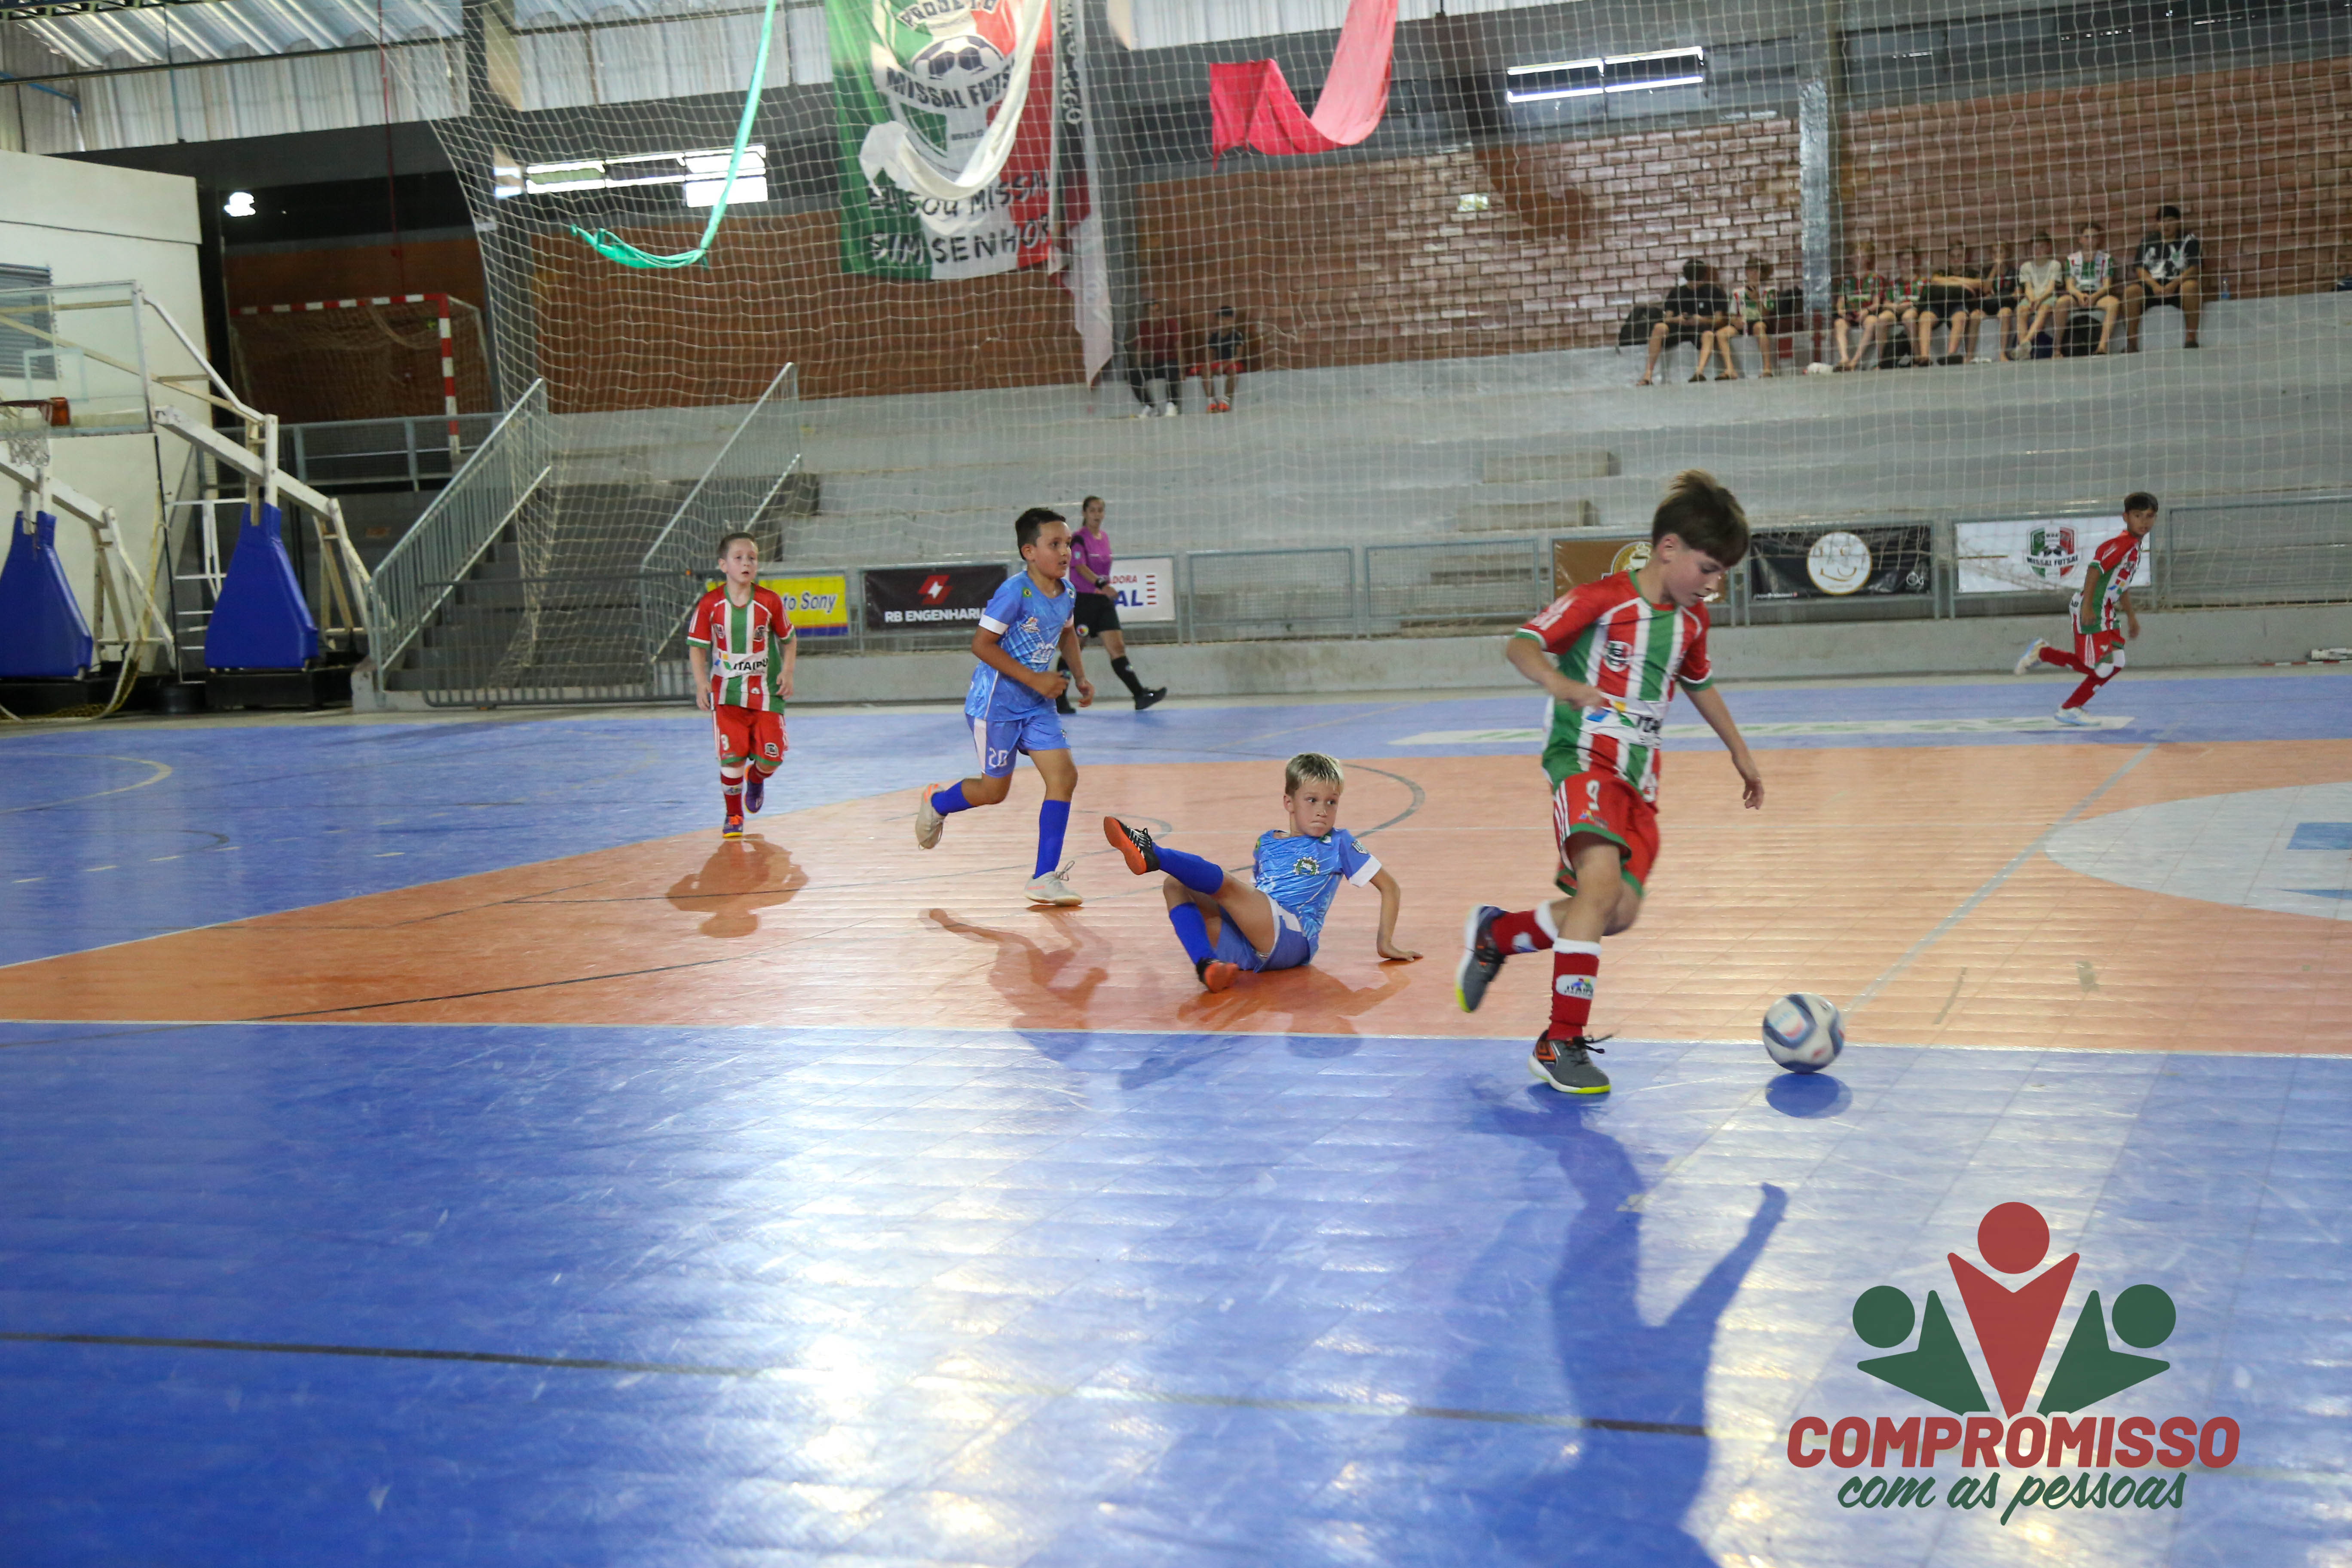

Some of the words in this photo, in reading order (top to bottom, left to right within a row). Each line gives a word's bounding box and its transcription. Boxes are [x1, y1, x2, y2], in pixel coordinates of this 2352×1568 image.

[887, 66, 968, 108] MISSAL
[967, 64, 1012, 107] FUTS
[906, 191, 958, 216] SOU
[871, 230, 924, 265] SIM
[932, 213, 1049, 263] SENHOR
[800, 591, 837, 613] Sony
[1115, 589, 1143, 606] AL
[885, 610, 903, 623] RB
